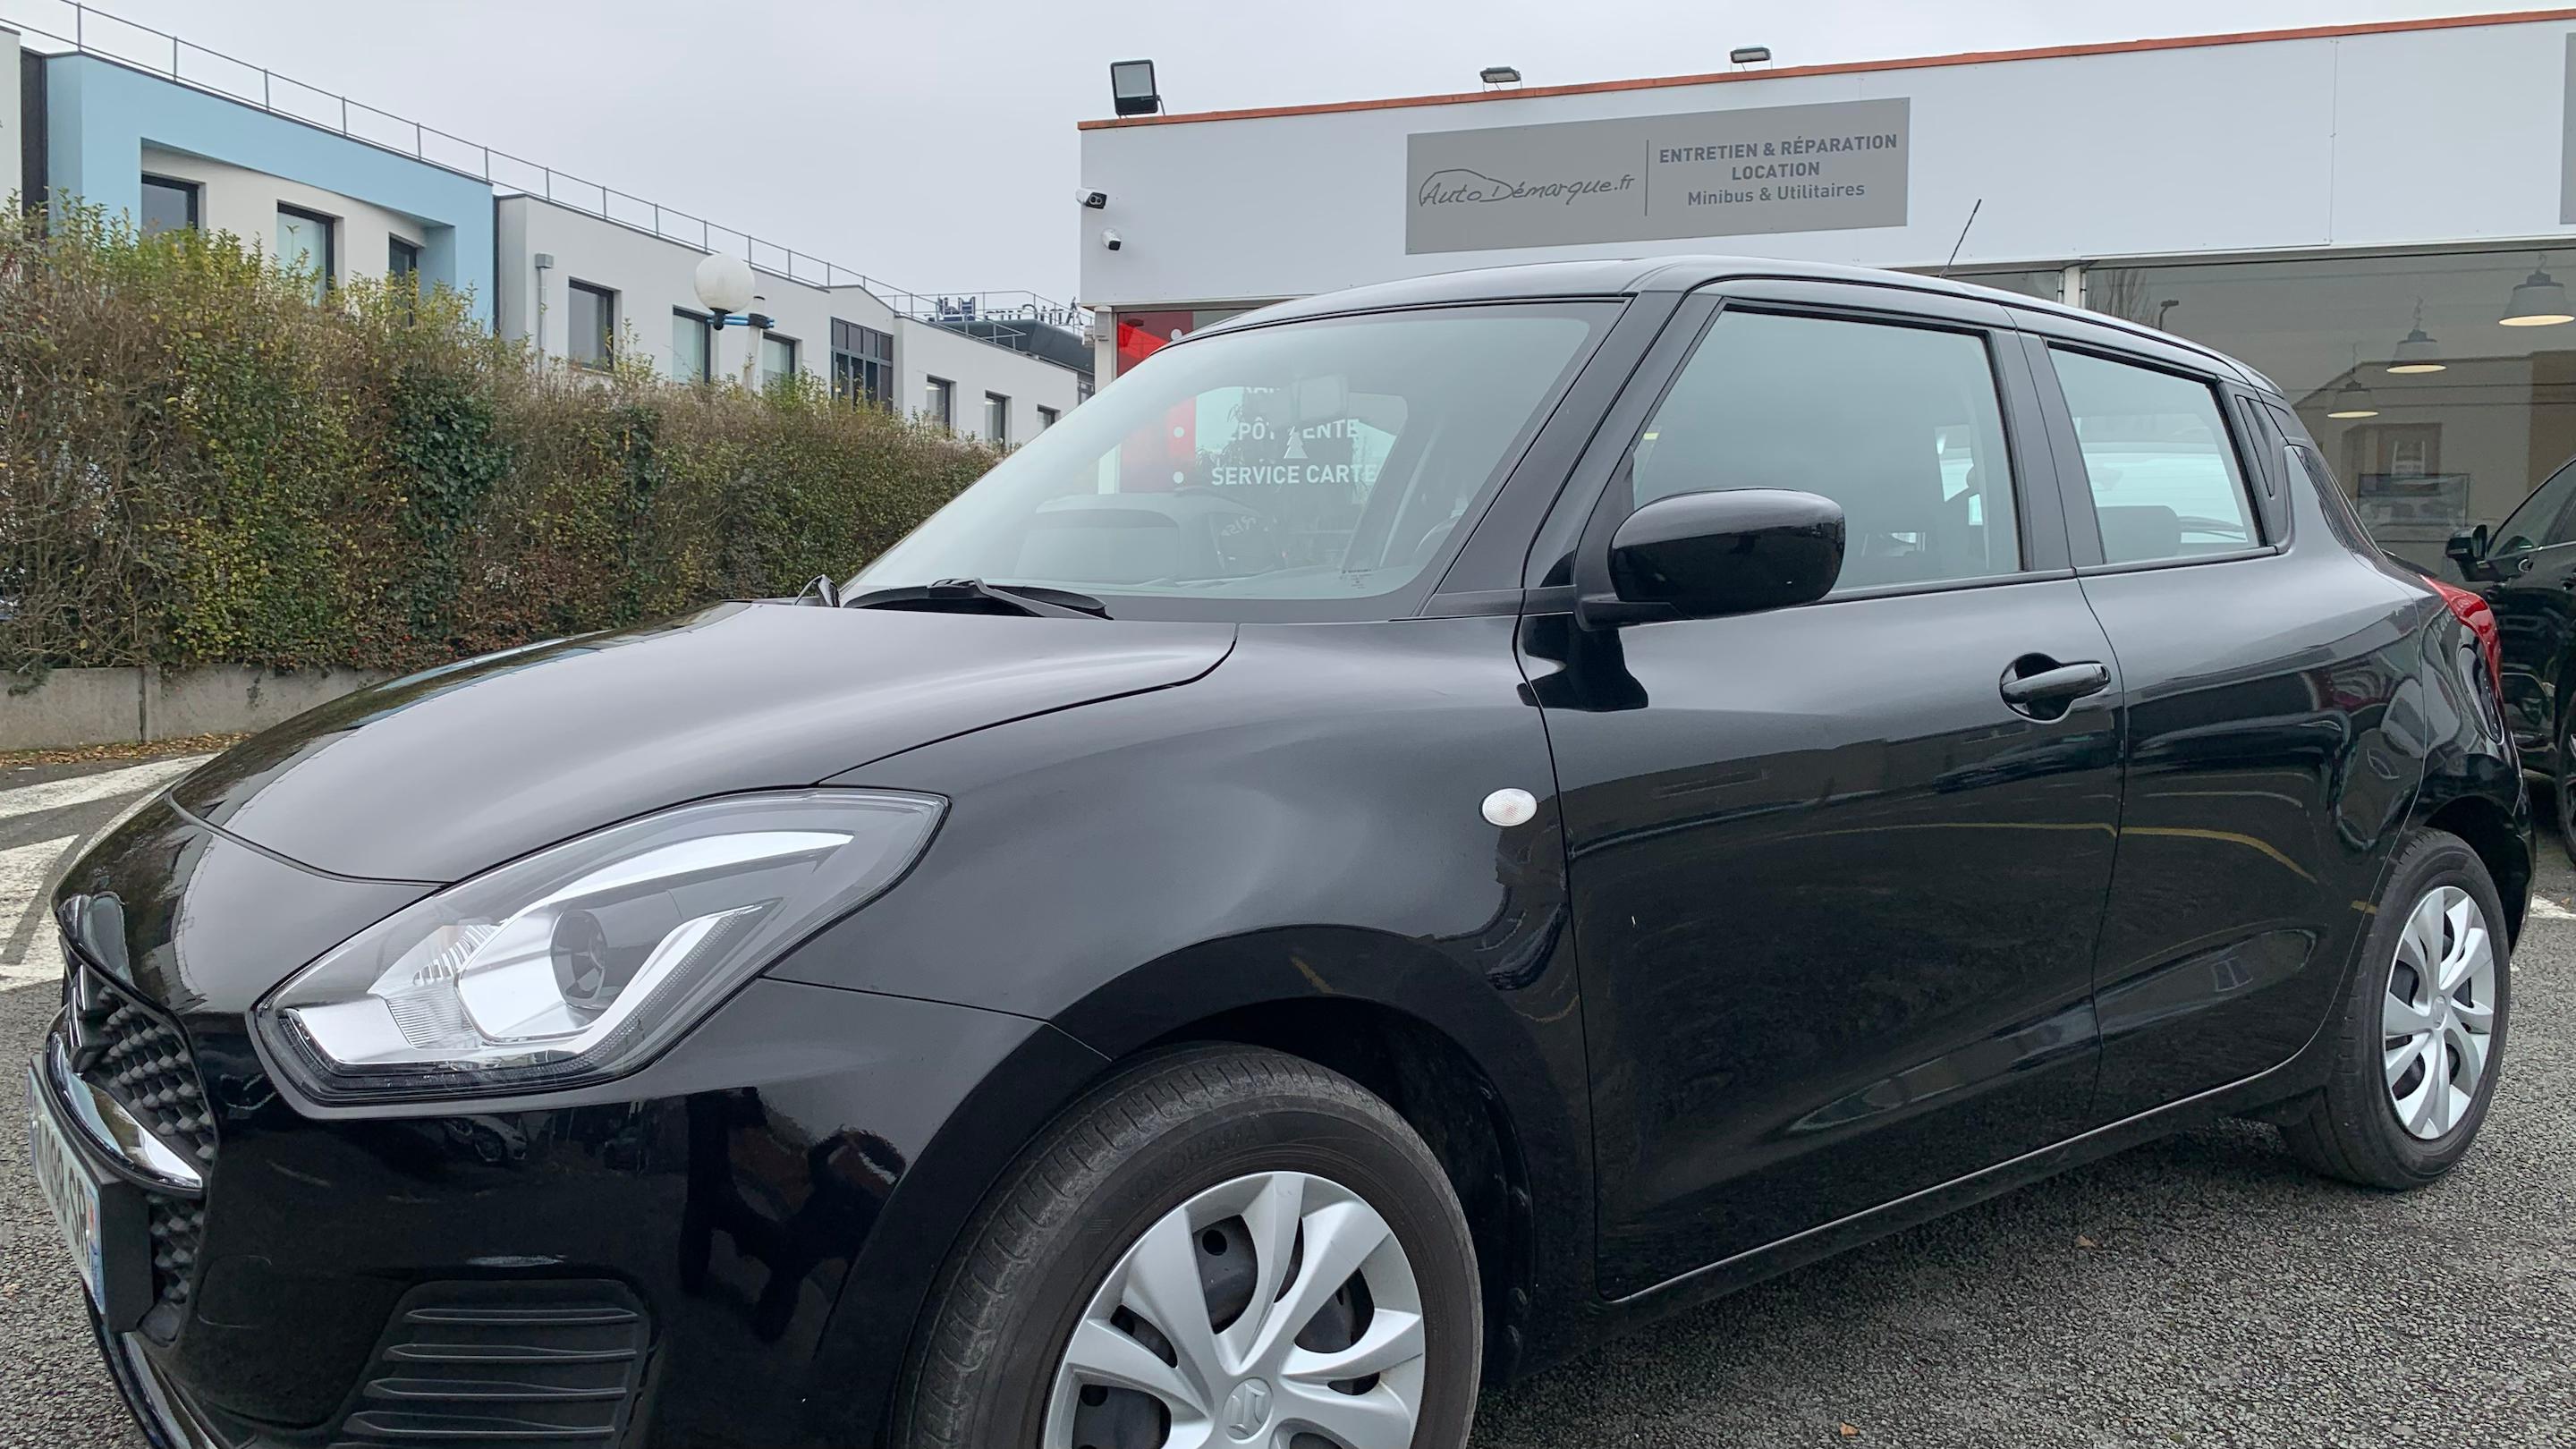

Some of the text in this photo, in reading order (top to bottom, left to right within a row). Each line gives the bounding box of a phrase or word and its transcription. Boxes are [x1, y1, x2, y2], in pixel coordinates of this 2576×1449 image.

[1659, 134, 1897, 163] ENTRETIEN & RÉPARATION
[1732, 161, 1820, 181] LOCATION
[1688, 182, 1865, 206] Minibus & Utilitaires
[1211, 464, 1377, 486] SERVICE CARTE
